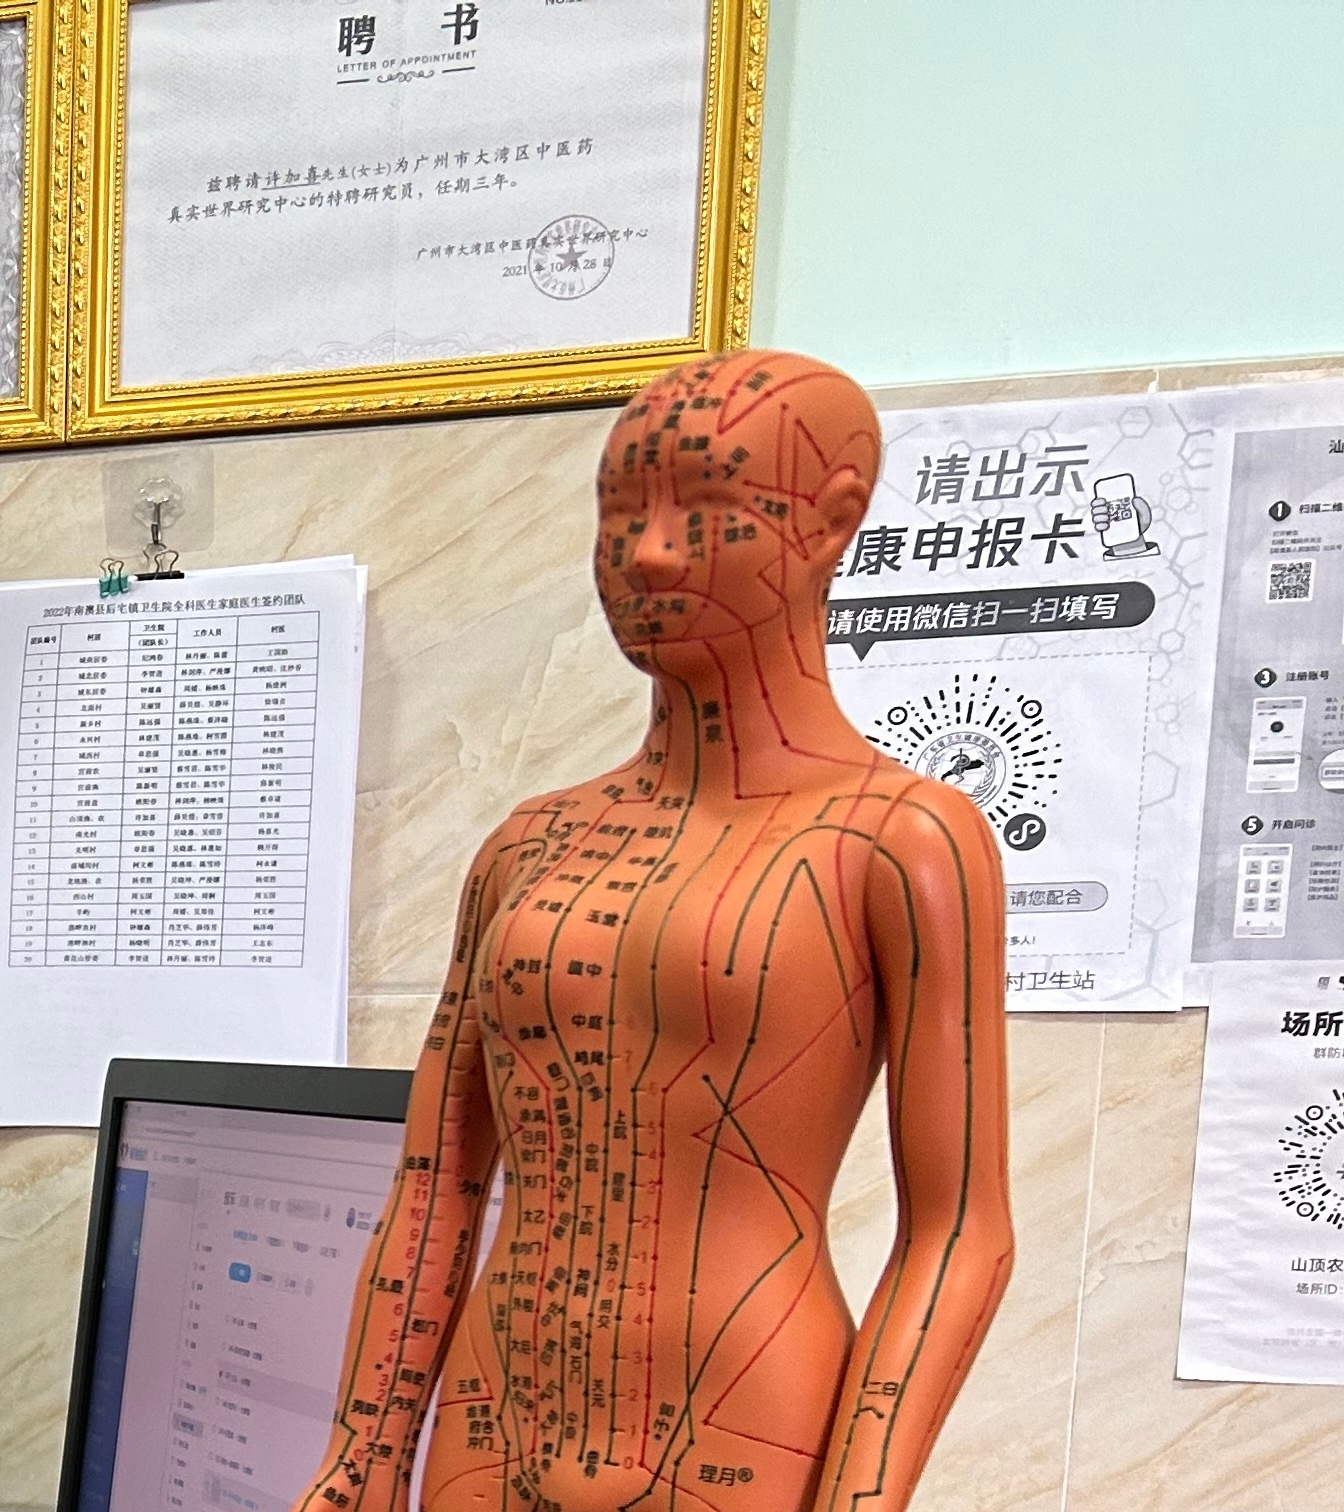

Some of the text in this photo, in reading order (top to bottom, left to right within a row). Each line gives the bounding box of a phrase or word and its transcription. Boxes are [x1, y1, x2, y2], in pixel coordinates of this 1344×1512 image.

[338, 2, 480, 58] 聘书
[337, 50, 477, 73] LETTER OF APPOINTMENT
[915, 444, 1090, 505] 请出示
[834, 512, 1086, 578] 康申报卡
[827, 593, 1121, 637] 请使用微信扫一扫填写
[1010, 887, 1083, 907] 请您配合
[1005, 970, 1096, 992] 村卫生站
[1280, 1010, 1344, 1038] 场所
